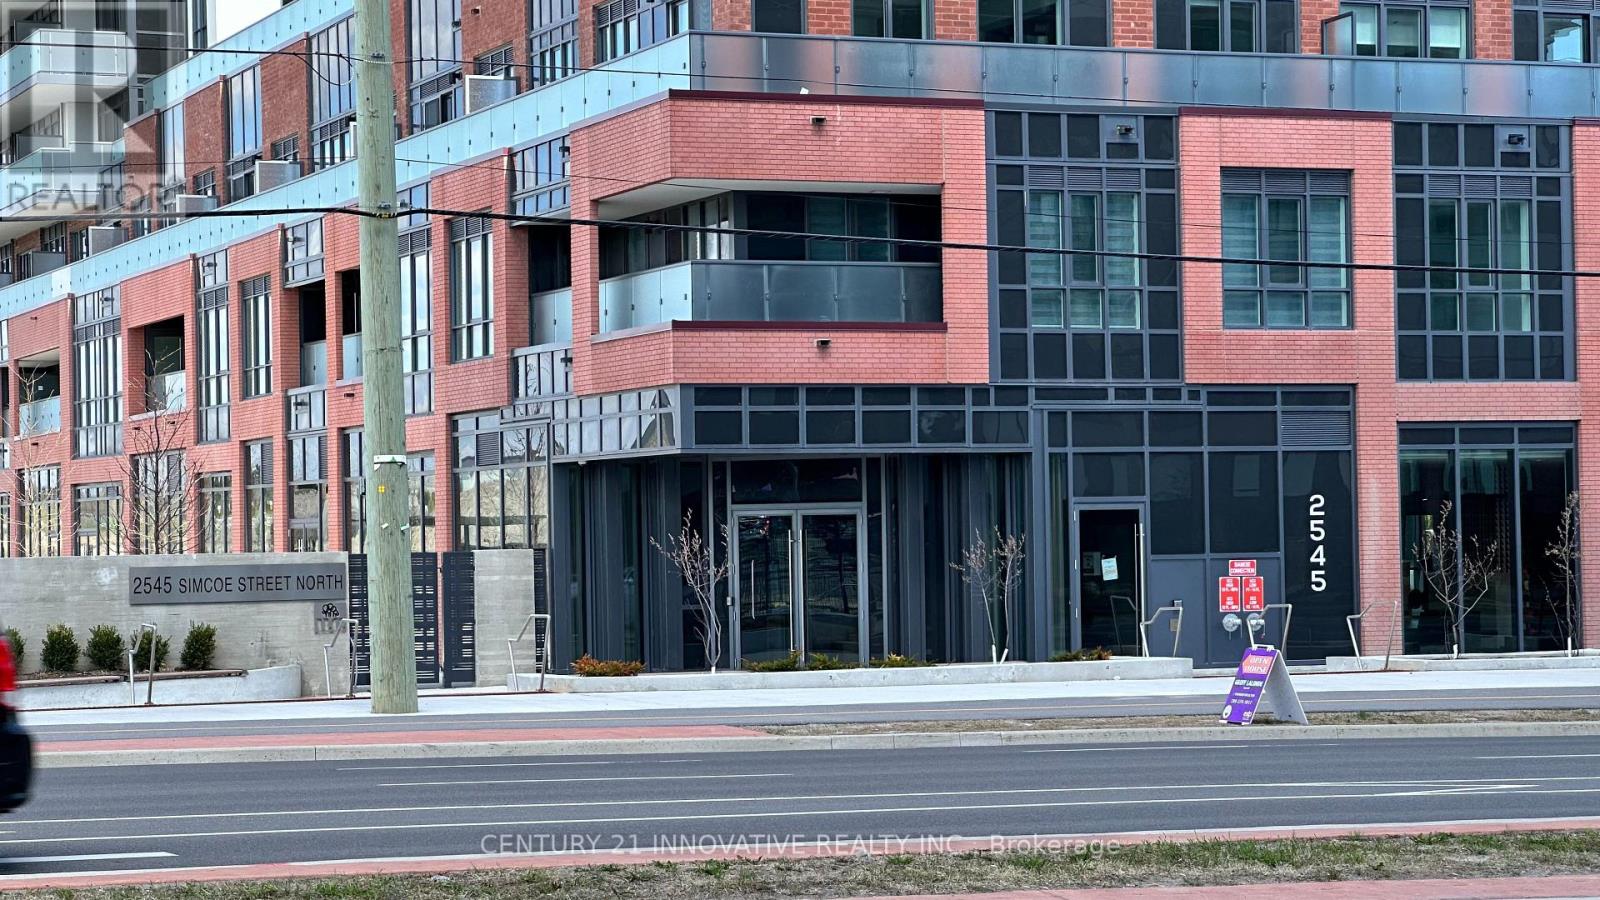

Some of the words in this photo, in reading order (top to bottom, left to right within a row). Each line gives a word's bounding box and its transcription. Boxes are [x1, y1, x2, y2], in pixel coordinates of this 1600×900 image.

[1309, 494, 1327, 592] 2545
[133, 576, 172, 594] 2545
[179, 577, 233, 593] SIMCOE
[238, 575, 292, 592] STREET
[296, 574, 343, 590] NORTH
[1249, 656, 1268, 664] OPEN
